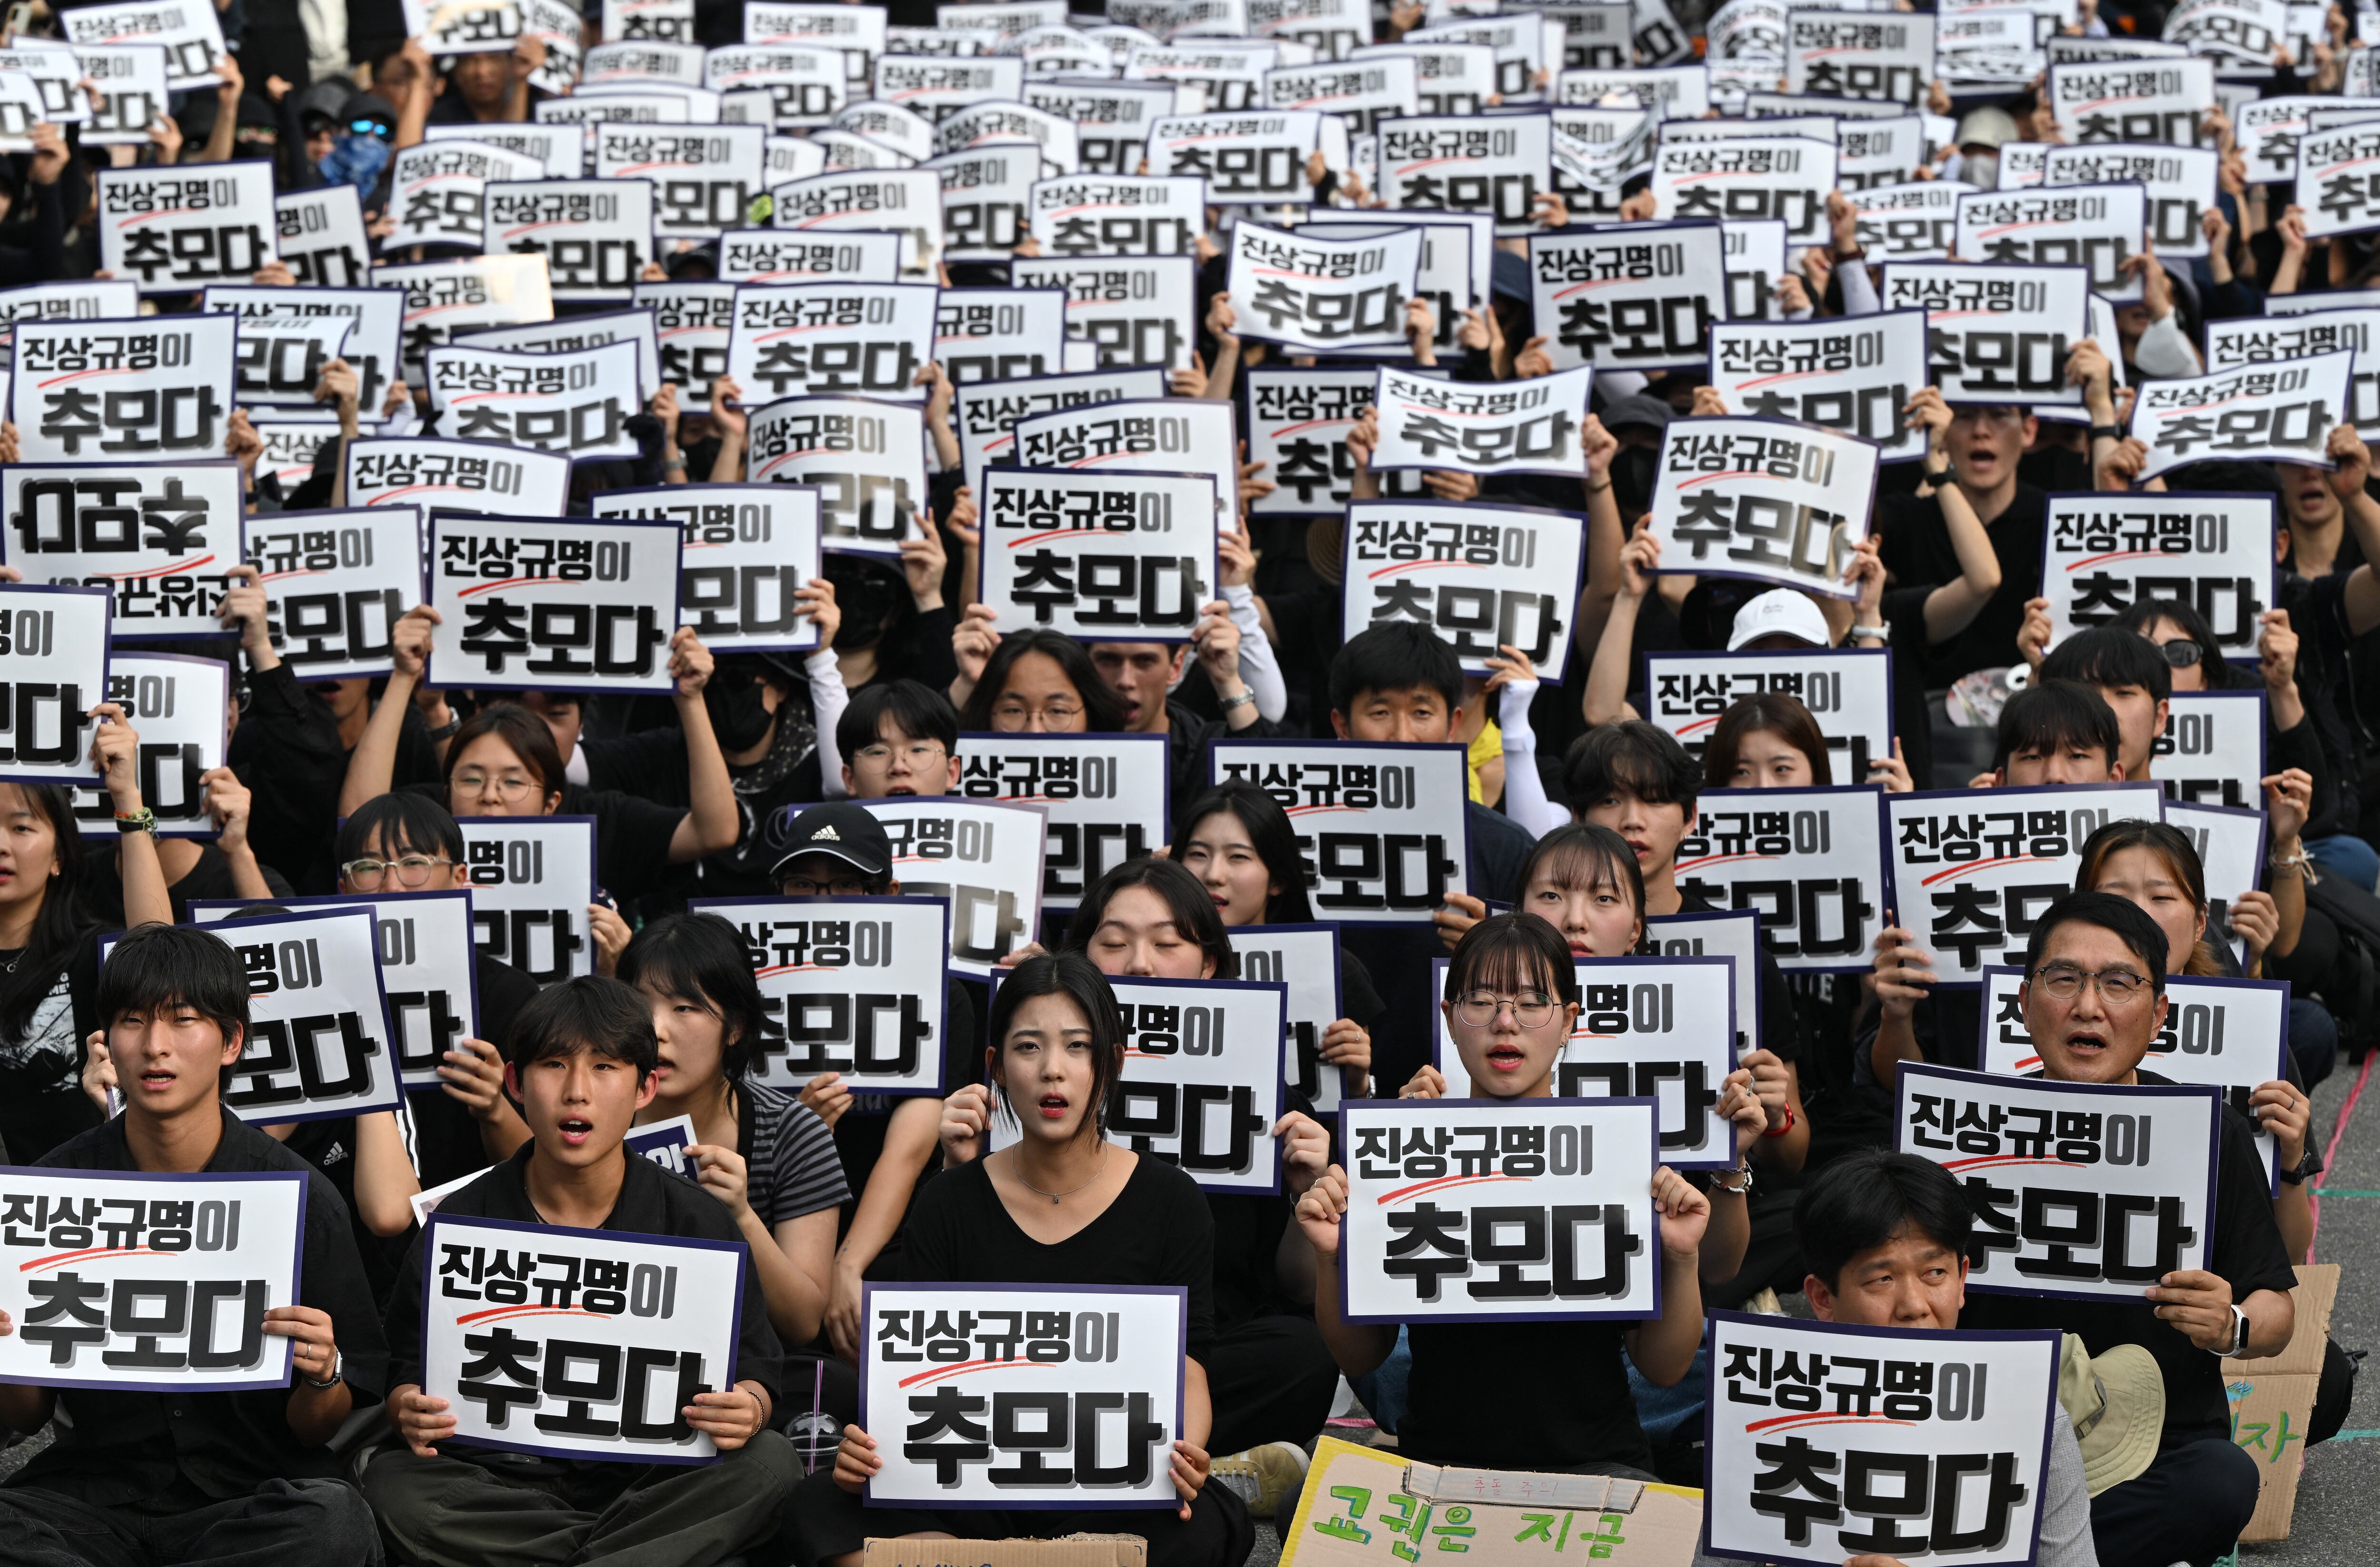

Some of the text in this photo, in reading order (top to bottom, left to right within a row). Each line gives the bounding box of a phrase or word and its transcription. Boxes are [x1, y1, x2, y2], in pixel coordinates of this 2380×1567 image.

[72, 8, 185, 44] 진상규명이
[1795, 22, 1906, 48] 진상규명이
[883, 66, 993, 89] 진상규명이
[1274, 70, 1385, 102] 진상규명이
[2062, 70, 2181, 100] 진상규명이
[606, 136, 732, 163] 진상규명이
[1159, 118, 1285, 138] 진상규명이
[1385, 129, 1516, 162] 진상규명이
[400, 151, 512, 182] 진상규명이
[942, 159, 1007, 188] 규명이
[1082, 139, 1146, 174] 모다
[1171, 147, 1306, 193] 추모다
[1665, 149, 1800, 173] 진상규명이
[2054, 157, 2182, 182] 진상규명이
[106, 176, 238, 213] 진상규명이
[403, 191, 484, 233] 추모
[493, 193, 617, 224] 진상규명이
[654, 180, 748, 227] 모다
[781, 183, 906, 221] 진상규명이
[1041, 184, 1169, 210] 진상규명이
[1854, 189, 1950, 210] 상규명이
[1966, 197, 2106, 225] 진상규명이
[944, 203, 1026, 250] 모다
[1053, 217, 1194, 256] 추모다
[123, 225, 270, 282] 추모다
[508, 239, 643, 289] 모다
[728, 243, 863, 273] 진상규명이
[1240, 234, 1385, 278] 진상규명이
[1536, 243, 1685, 284] 진상규명이
[742, 297, 895, 329] 진상규명이
[1251, 280, 1405, 339] 추모다
[1891, 278, 2046, 313] 진상규명이
[937, 306, 1023, 337] 규명이
[1066, 318, 1184, 369] 모다
[1558, 295, 1719, 359] 추모다
[2215, 323, 2368, 364] 진상규명이
[23, 333, 192, 371] 진상규명이
[238, 335, 328, 393] 모다
[754, 342, 919, 394] 추모다
[1720, 331, 1884, 373] 진상규명이
[436, 360, 597, 394] 진상규명이
[1388, 377, 1549, 415] 진상규명이
[2147, 368, 2309, 408] 진상규명이
[40, 385, 224, 455] 추모다
[457, 397, 627, 452] 추모다
[1255, 386, 1376, 421] 진상규명
[753, 415, 885, 463] 진상규명이
[1024, 417, 1190, 466] 진상규명이
[1401, 409, 1575, 465] 추모다
[2154, 399, 2332, 455] 추모다
[355, 453, 524, 495] 진상규명이
[1669, 434, 1835, 487] 진상규명이
[772, 472, 916, 541] 모다
[993, 488, 1171, 532] 진상규명이
[246, 528, 373, 573] 상규명이
[1356, 521, 1537, 569] 진상규명이
[1673, 489, 1854, 582] 추모다
[2054, 513, 2228, 554] 진상규명이
[441, 535, 630, 581] 진상규명이
[681, 565, 812, 636] 모다
[1011, 549, 1207, 627] 추모다
[268, 589, 407, 665] 모다
[461, 597, 666, 678] 추모다
[947, 756, 1117, 799] 상규명이
[881, 818, 993, 863] 규명이
[1683, 810, 1830, 856] 상규명이
[1043, 823, 1153, 897] 모다
[1297, 833, 1458, 910] 모다
[748, 921, 892, 968] 상규명이
[228, 1011, 381, 1108] 모다
[1107, 1079, 1268, 1175] 모다
[1910, 1093, 2152, 1167] 진상규명이
[323, 1152, 348, 1165] adidas
[1356, 1125, 1593, 1179] 진상규명이
[0, 1194, 240, 1252] 진상규명이
[1964, 1176, 2197, 1285] 추모다
[1383, 1202, 1644, 1303] 추모다
[439, 1243, 678, 1319] 진상규명이
[20, 1271, 270, 1371] 추모다
[878, 1310, 1120, 1363] 진상규명이
[458, 1328, 713, 1445] 추모다
[1724, 1343, 1987, 1421] 진상규명이
[904, 1386, 1167, 1489] 추모다
[1521, 1480, 1558, 1498] 주의
[1750, 1436, 2029, 1555] 추모다
[1313, 1486, 1625, 1563] 교권은 지금
